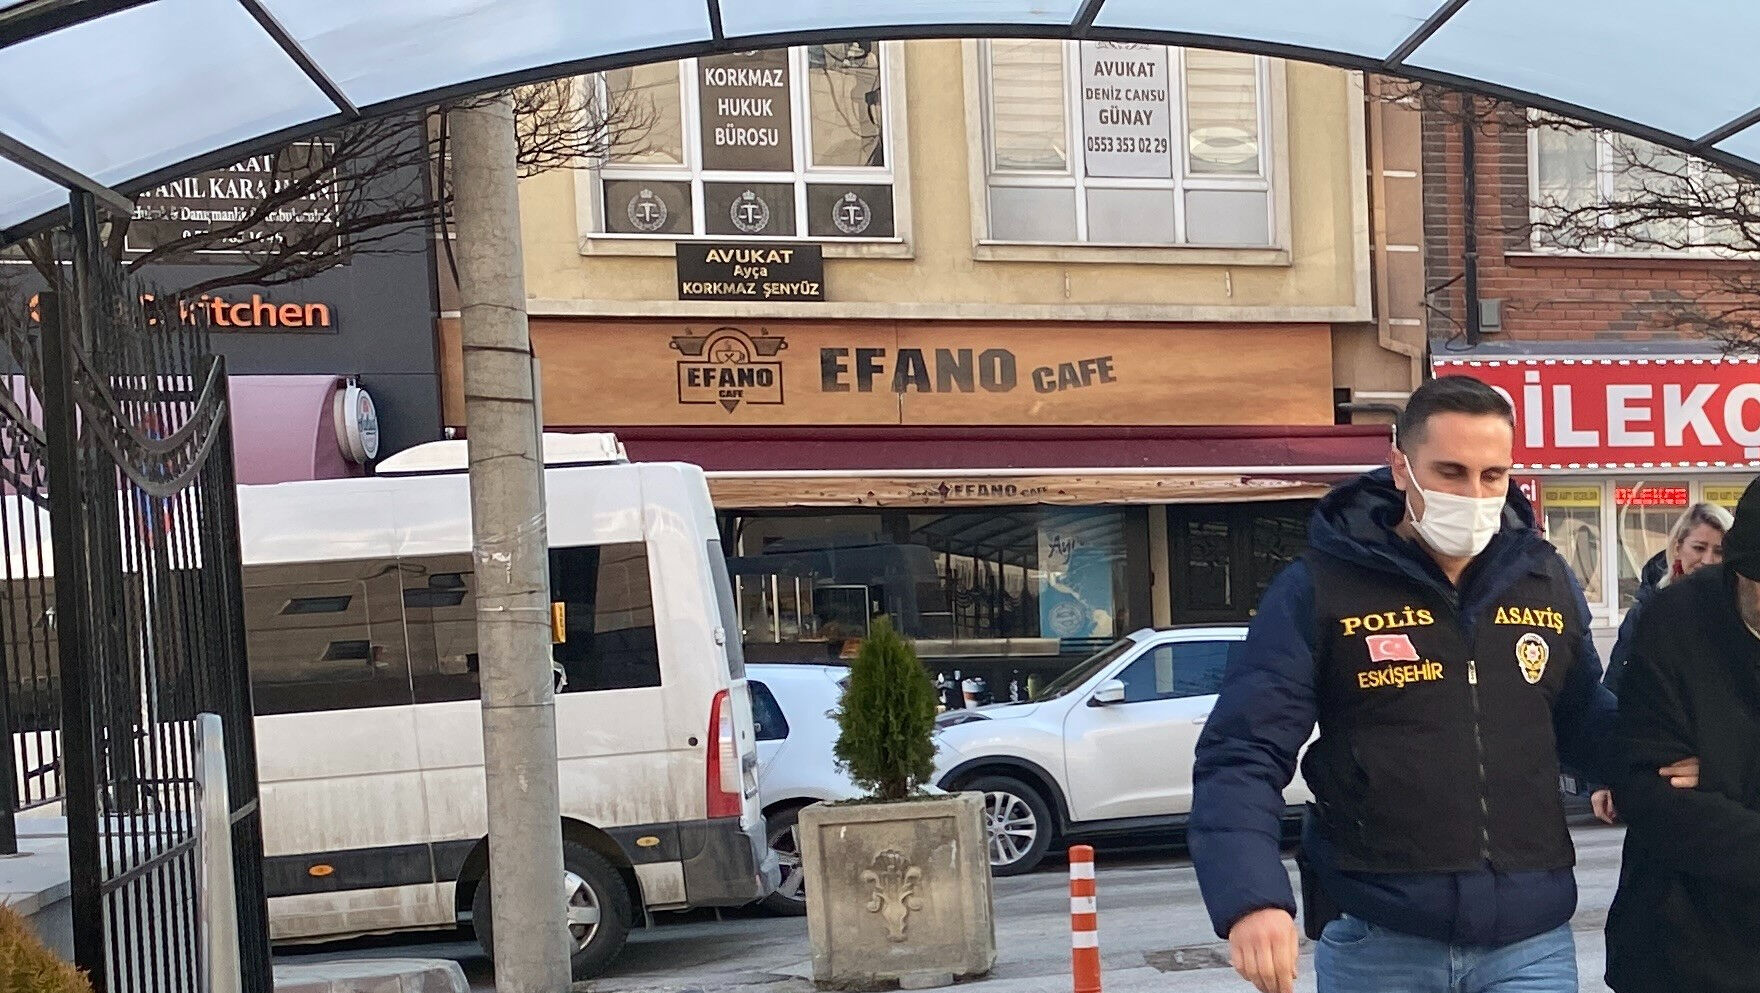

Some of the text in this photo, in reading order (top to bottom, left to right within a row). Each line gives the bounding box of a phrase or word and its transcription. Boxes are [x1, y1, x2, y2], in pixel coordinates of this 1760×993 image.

[705, 68, 783, 87] KORKMAZ
[1094, 61, 1155, 77] AVUKAT
[1086, 85, 1165, 102] DENİZ CANSU
[718, 98, 773, 116] HUKUK
[1099, 105, 1153, 126] GÜNAY
[715, 123, 778, 146] BÜROSU
[1087, 136, 1167, 153] 0553 353 02 29
[706, 249, 793, 264] AVUKAT
[733, 264, 768, 280] Ayça
[683, 280, 819, 298] KORKMAZ ŞENYÜZ
[688, 368, 773, 387] EFANO
[820, 348, 1117, 394] EFANO CAFE
[719, 389, 743, 398] CAFE
[1340, 606, 1564, 636] POLİS ASAYİŞ
[1357, 659, 1444, 688] ESKİŞEHİR
